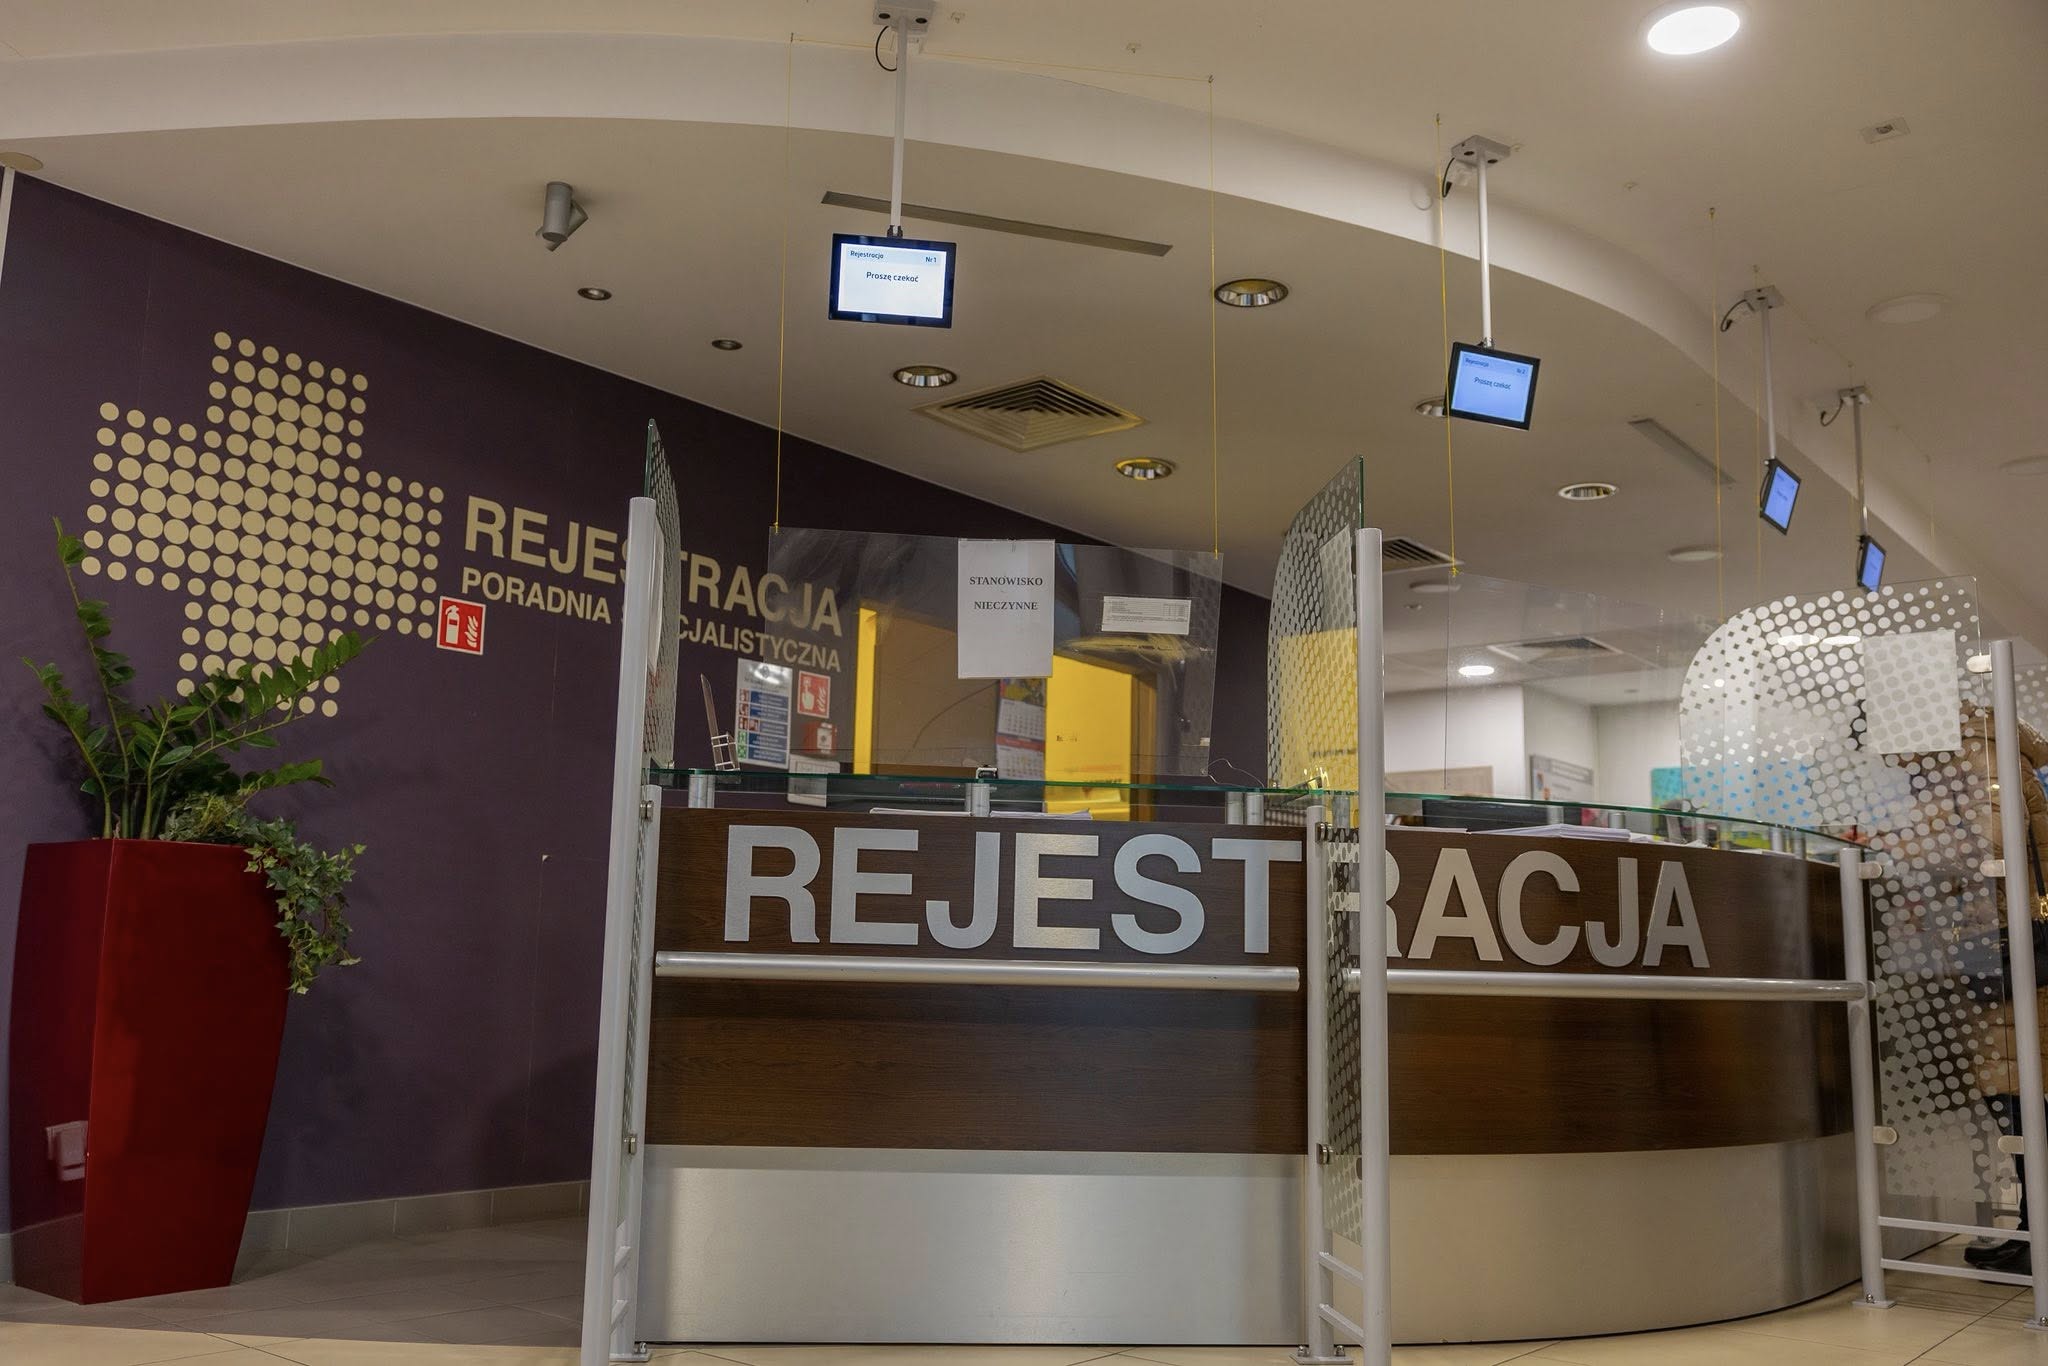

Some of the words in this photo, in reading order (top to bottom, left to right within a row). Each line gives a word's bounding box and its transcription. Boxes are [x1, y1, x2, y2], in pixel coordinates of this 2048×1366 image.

[850, 250, 884, 260] Rejestracja
[866, 271, 892, 282] Proszę
[893, 275, 919, 283] czekać
[1473, 376, 1493, 388] Proszę
[465, 495, 842, 637] REJERACJA
[969, 576, 1043, 586] STANOWISKO
[461, 566, 612, 625] PORADNIA
[974, 600, 1038, 611] NIECZYNNE
